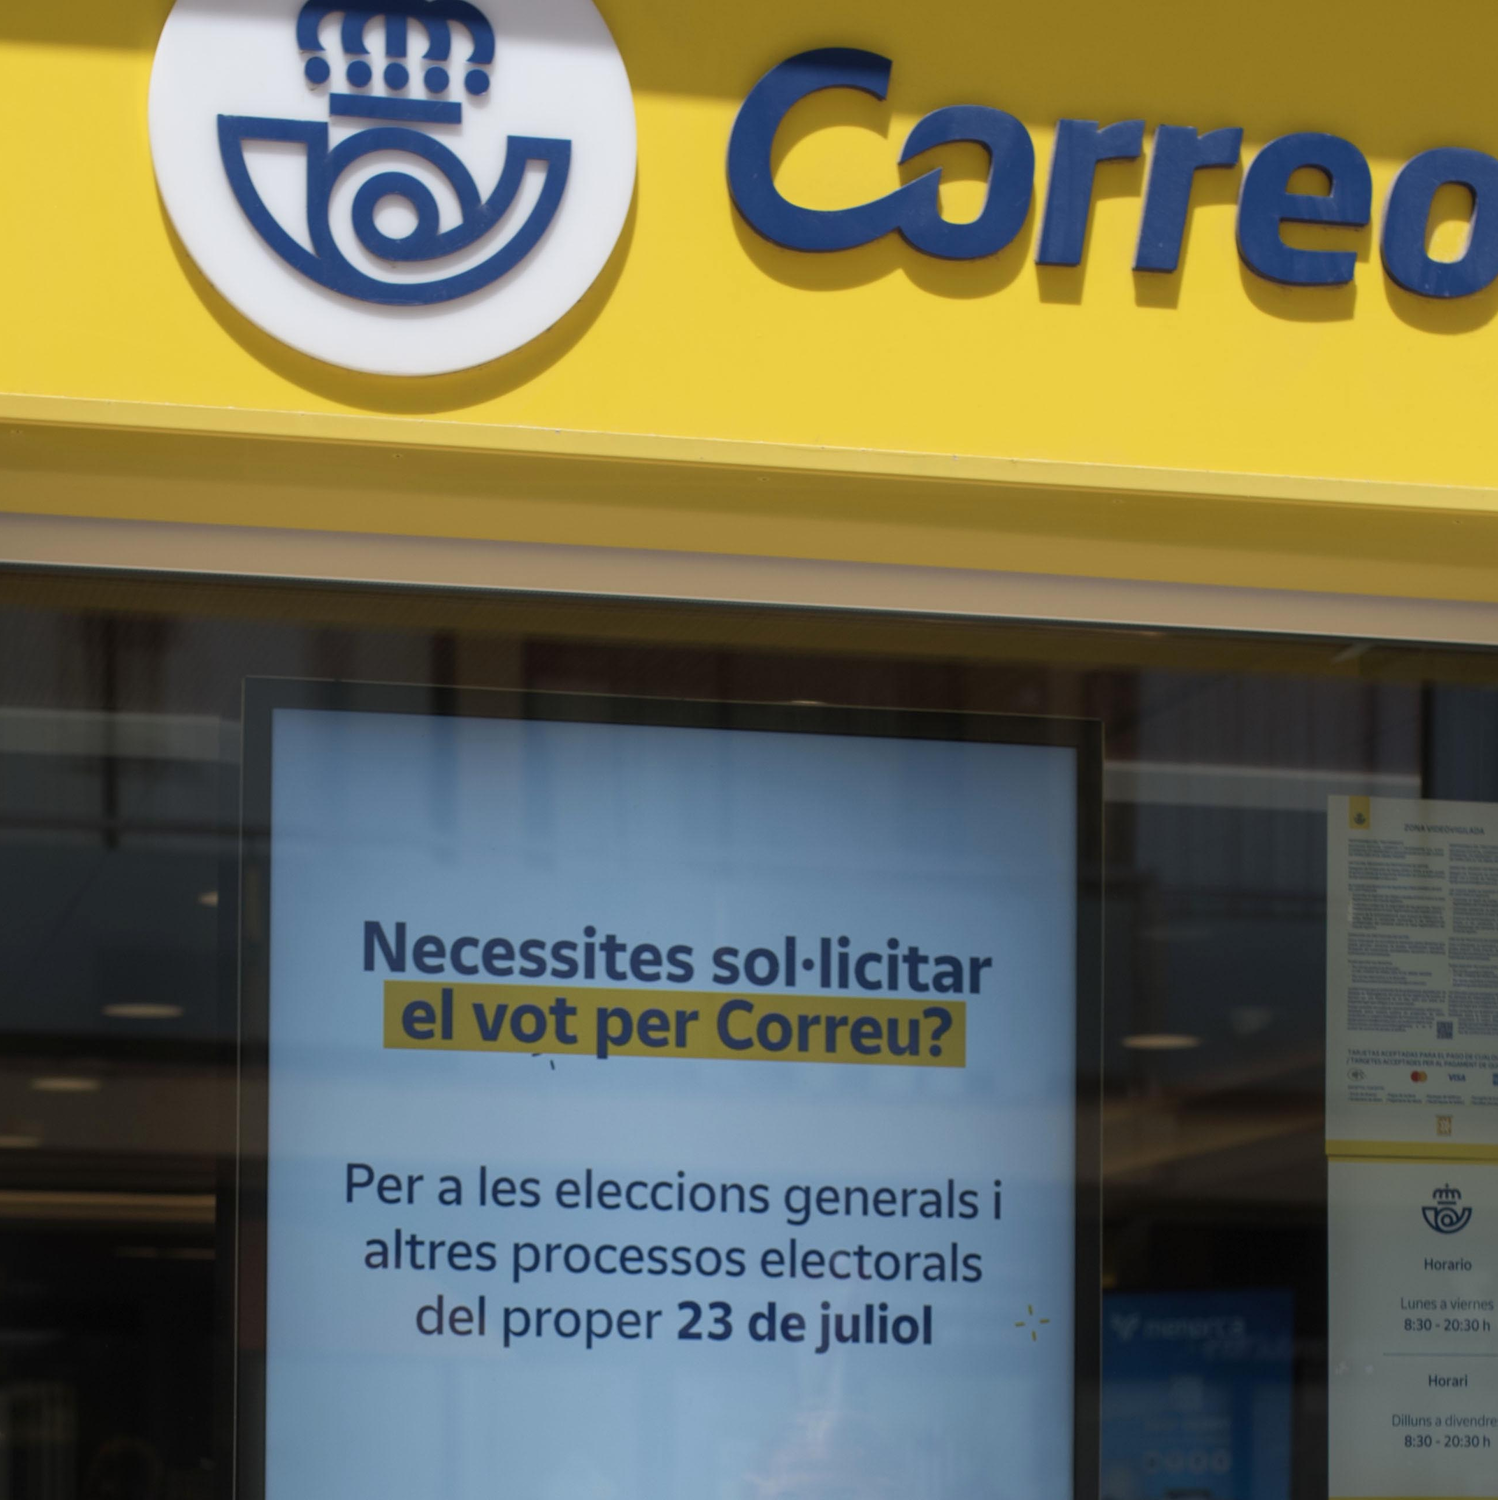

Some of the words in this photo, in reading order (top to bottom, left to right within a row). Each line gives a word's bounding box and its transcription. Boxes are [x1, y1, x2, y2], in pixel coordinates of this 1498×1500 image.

[364, 921, 694, 983] Necessites
[713, 936, 993, 994] sol·licitar
[402, 988, 453, 1040] el
[472, 998, 577, 1044] vot
[597, 1007, 699, 1059] per
[717, 999, 953, 1057] Correu?
[1448, 1073, 1466, 1082] VISA
[347, 1163, 423, 1204] Per
[438, 1176, 461, 1205] a
[480, 1166, 540, 1207] les
[556, 1169, 769, 1213] eleccions
[785, 1179, 979, 1226] generals
[995, 1180, 1001, 1219] i
[365, 1229, 496, 1271] altres
[513, 1243, 745, 1283] processos
[761, 1238, 982, 1283] electorals
[1424, 1257, 1472, 1272] Horario
[1401, 1297, 1438, 1311] Lunes
[1440, 1301, 1448, 1311] a
[1450, 1297, 1494, 1311] viernes
[416, 1295, 485, 1336] del
[504, 1307, 662, 1349] proper
[678, 1301, 732, 1341] 23
[749, 1302, 805, 1342] de
[816, 1301, 932, 1353] juliol
[1404, 1318, 1432, 1331] 8:30
[1444, 1319, 1480, 1332] 20:30
[1483, 1319, 1490, 1332] h
[1428, 1374, 1468, 1388] Horari
[1392, 1414, 1432, 1428] Dilluns
[1435, 1418, 1442, 1428] a
[1404, 1435, 1432, 1448] 8:30
[1444, 1435, 1480, 1448] 20:30
[1483, 1435, 1490, 1448] h
